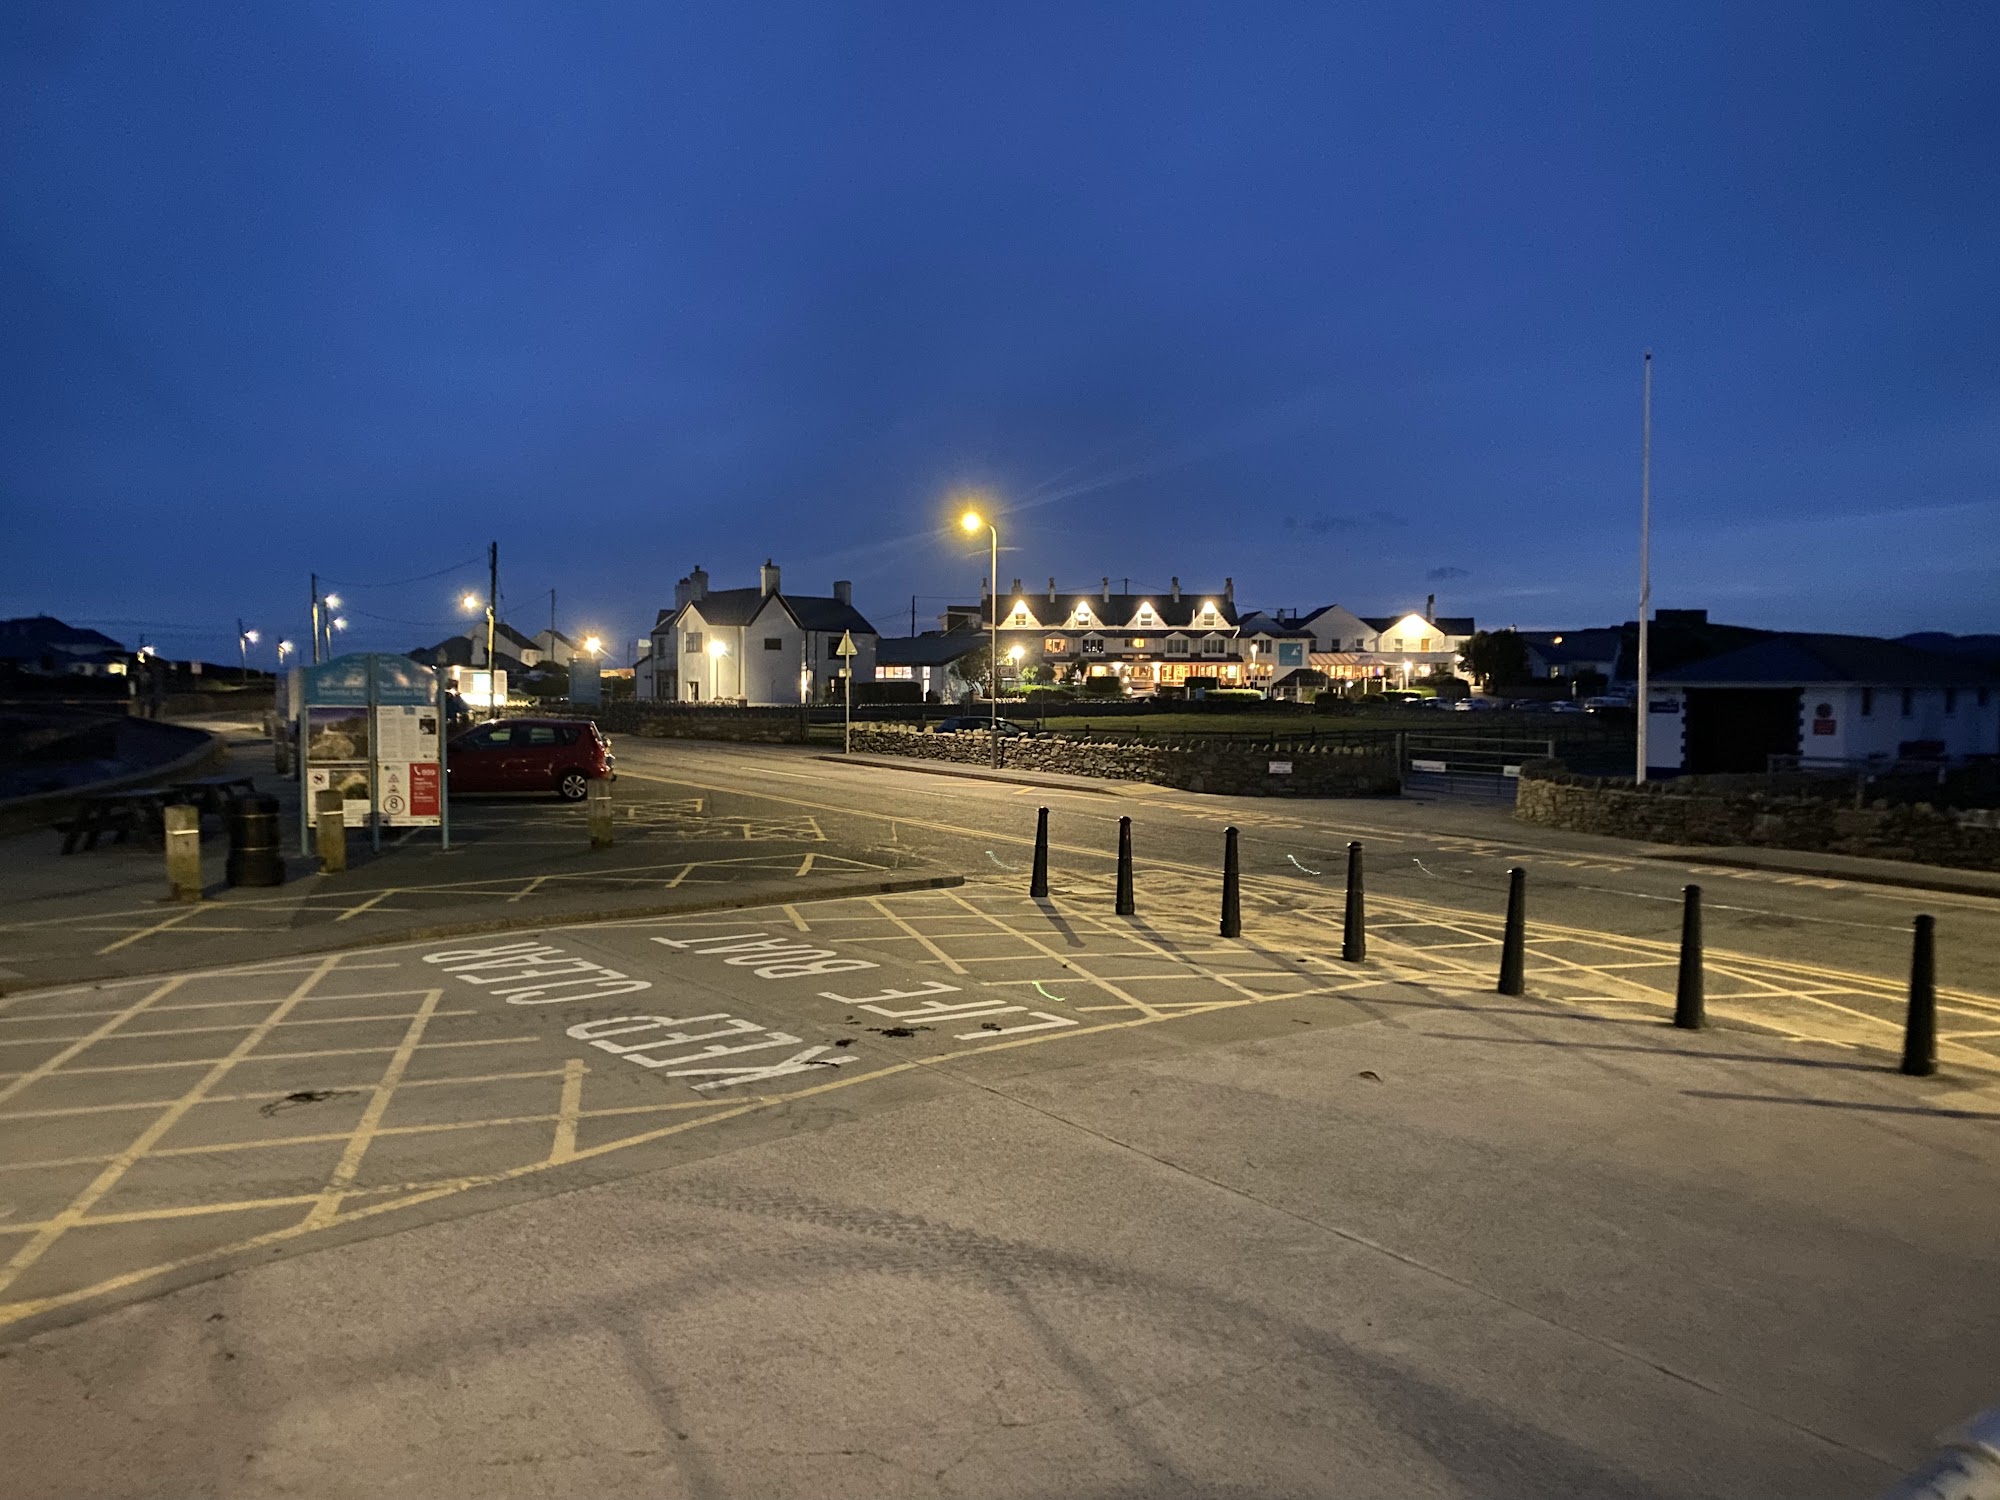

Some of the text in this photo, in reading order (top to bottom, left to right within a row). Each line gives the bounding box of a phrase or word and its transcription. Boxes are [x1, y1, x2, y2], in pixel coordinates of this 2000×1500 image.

[421, 941, 858, 1091] KEEP CLEAR
[650, 933, 1079, 1040] LIFE BOAT
